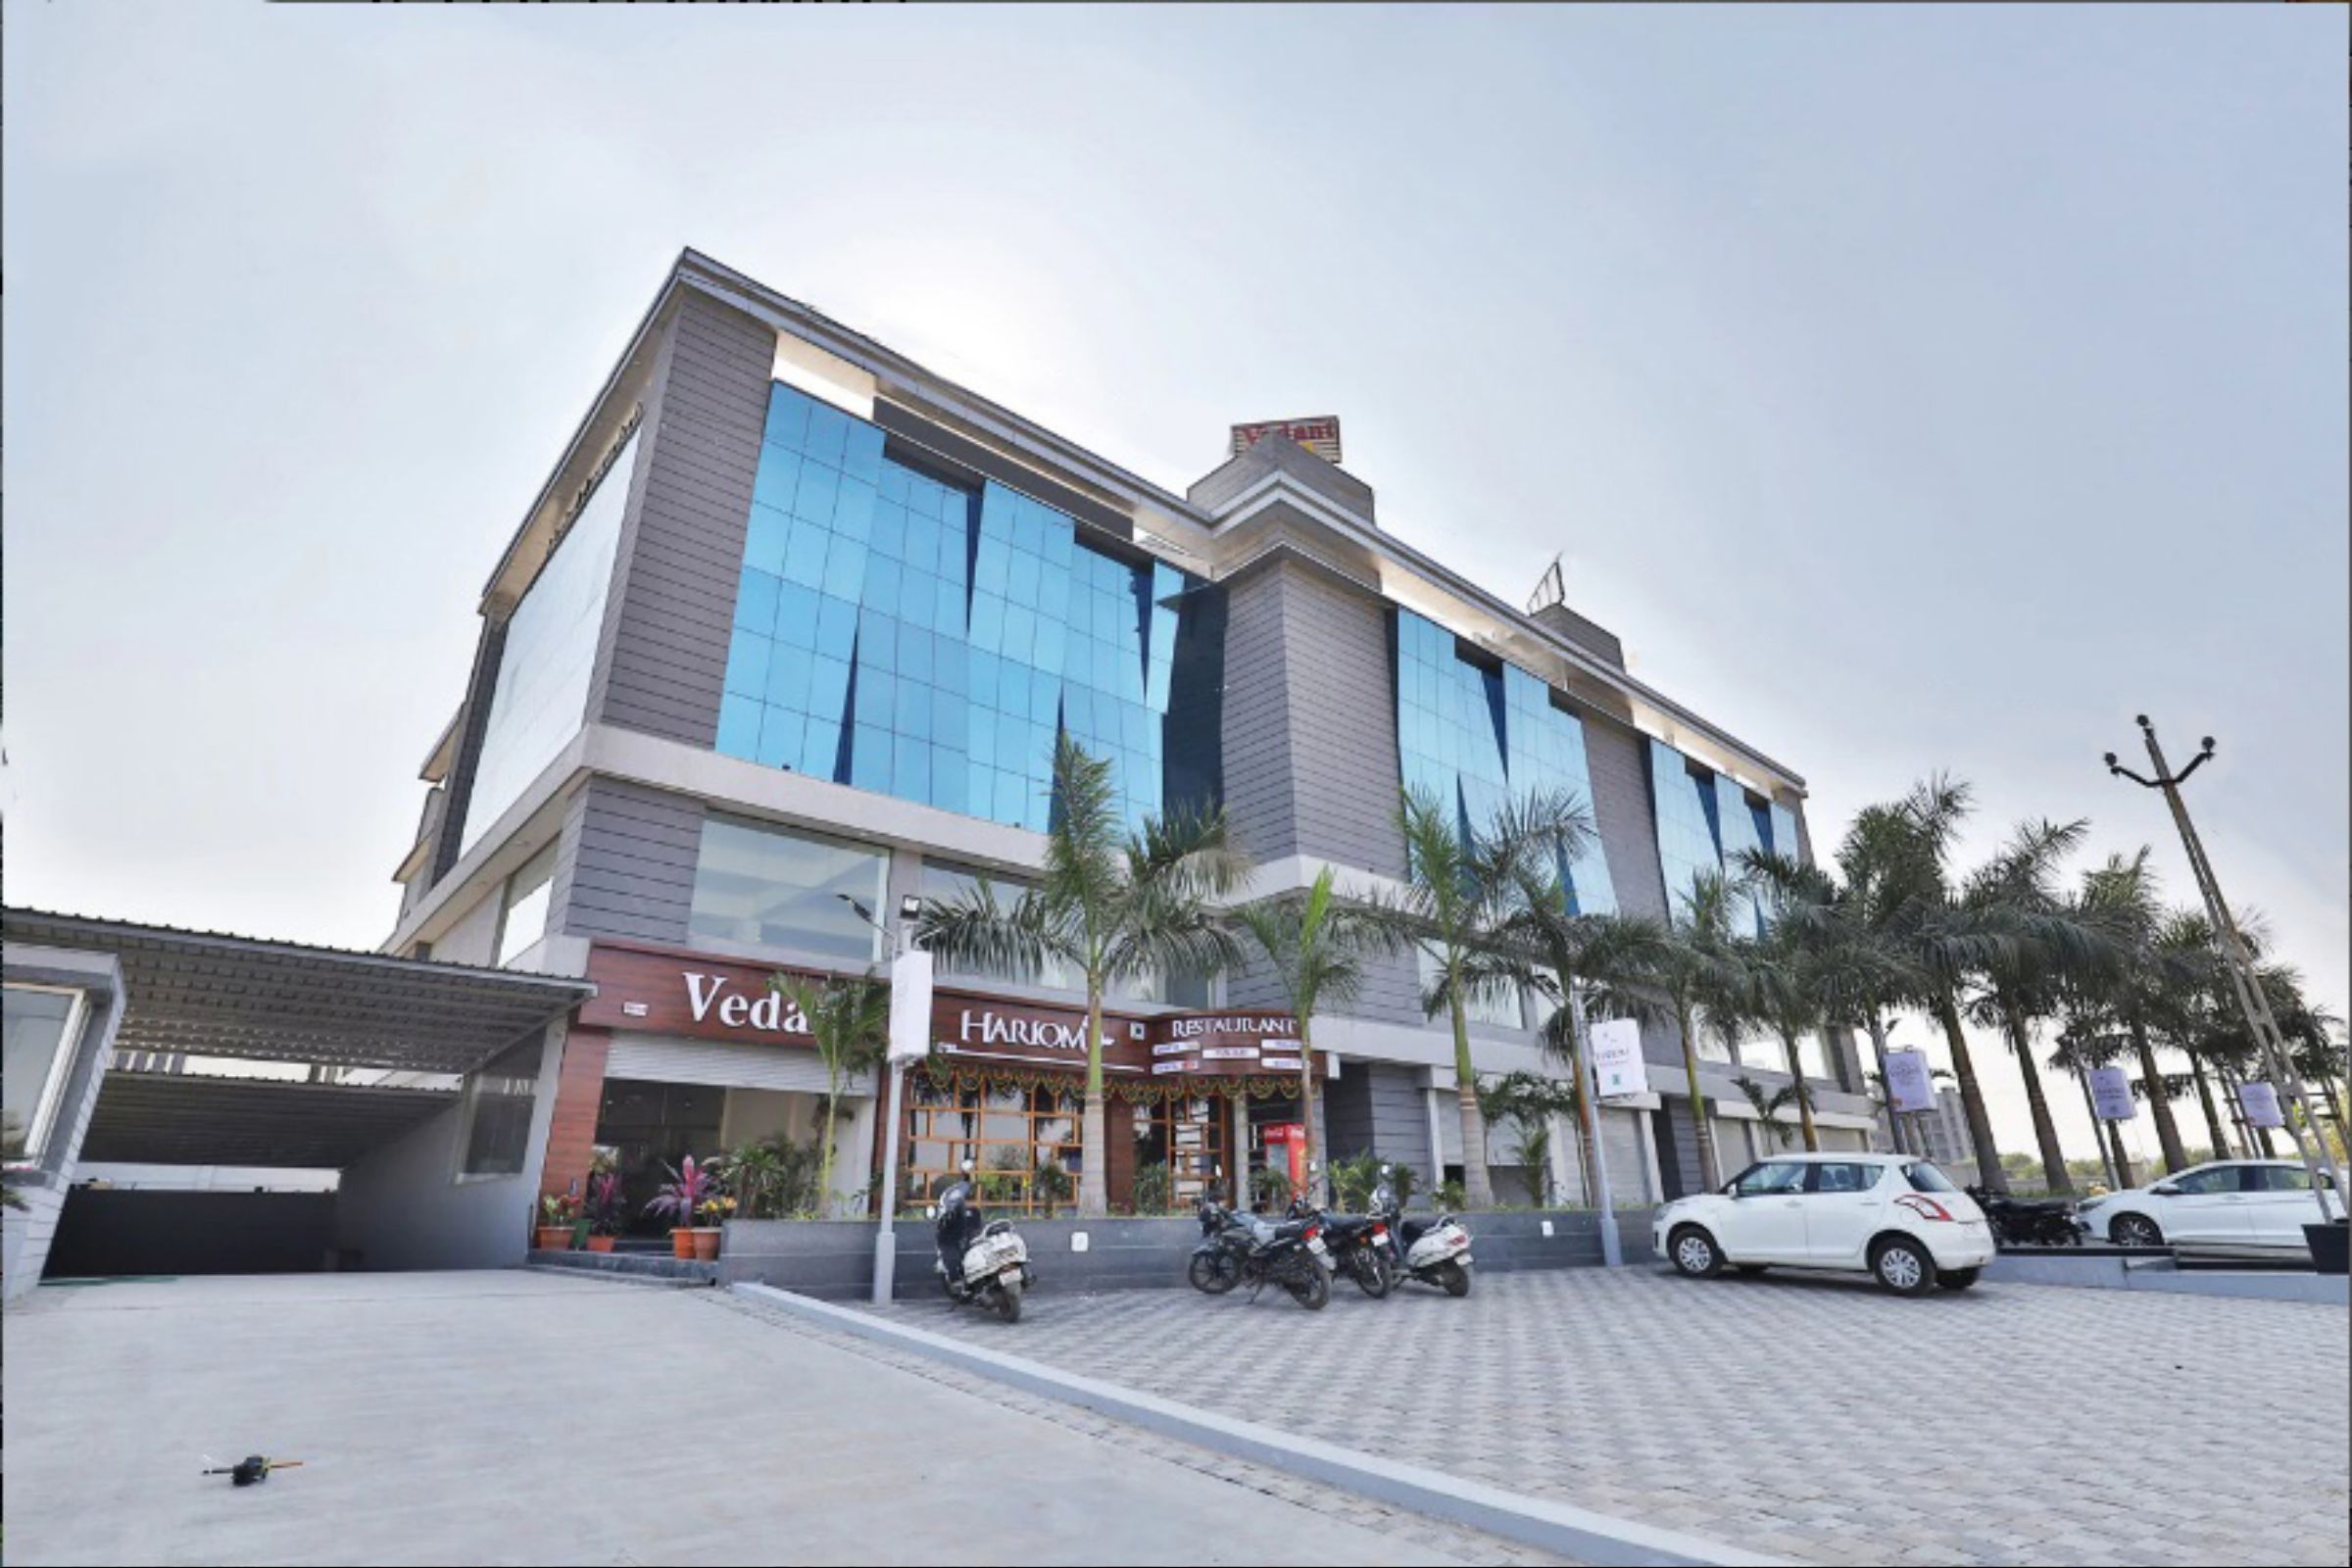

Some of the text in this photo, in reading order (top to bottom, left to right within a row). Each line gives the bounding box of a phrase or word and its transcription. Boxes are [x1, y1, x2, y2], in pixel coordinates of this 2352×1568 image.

[1239, 419, 1335, 445] Vdant
[682, 971, 831, 1036] Veda
[1172, 1016, 1298, 1038] RESTAURANT
